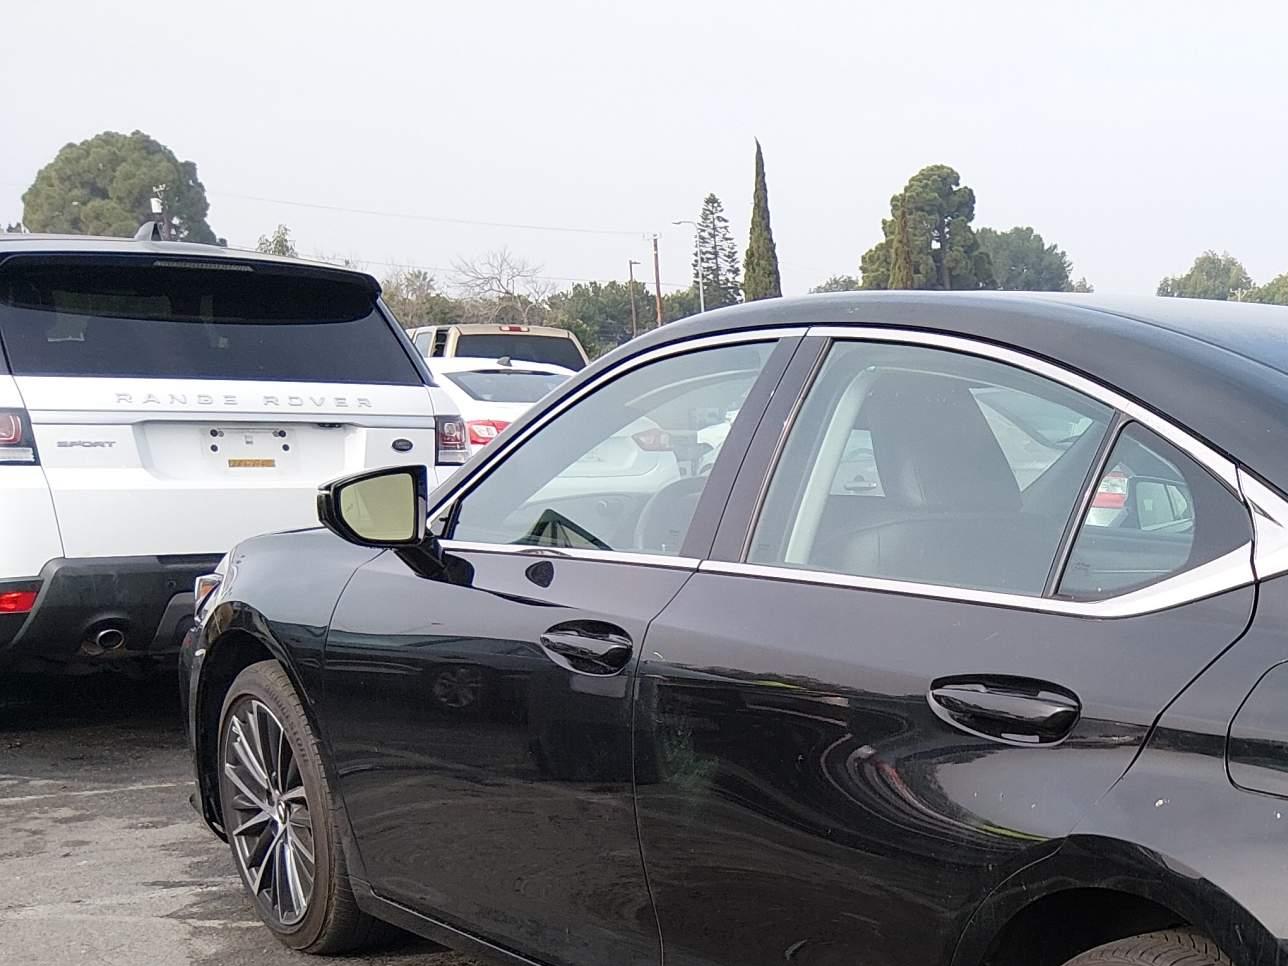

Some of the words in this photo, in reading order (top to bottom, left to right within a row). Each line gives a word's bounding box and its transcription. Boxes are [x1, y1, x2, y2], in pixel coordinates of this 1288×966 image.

[115, 393, 239, 406] RANGE
[263, 395, 374, 408] ROVER
[56, 440, 117, 448] SPORT
